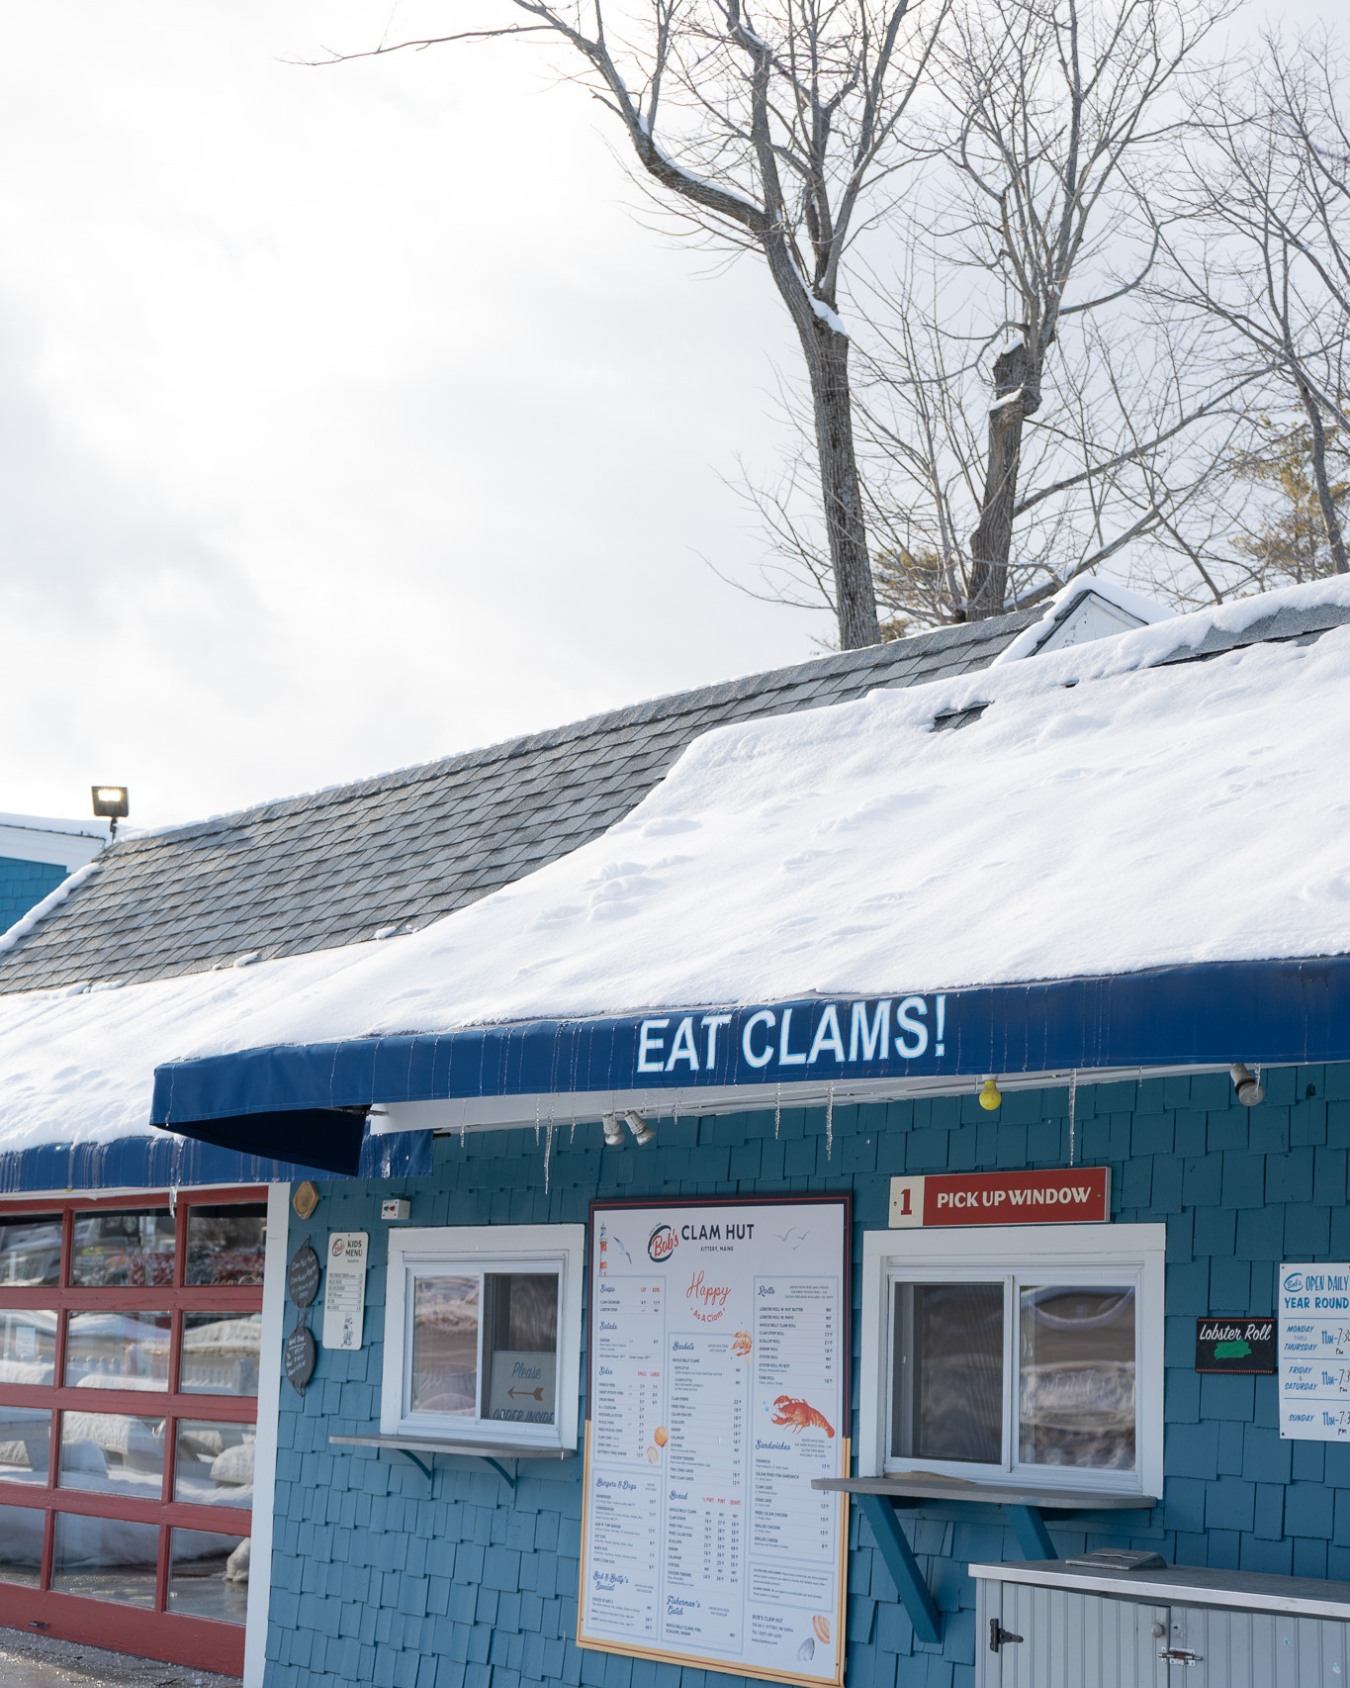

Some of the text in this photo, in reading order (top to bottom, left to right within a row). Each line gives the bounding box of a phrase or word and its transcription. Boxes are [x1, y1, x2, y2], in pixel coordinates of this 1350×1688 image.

[637, 994, 946, 1073] EAT CLAMS!
[900, 1187, 1091, 1215] 1 PICK UP WINDOW
[681, 1224, 754, 1240] CLAM HUT
[652, 1229, 678, 1256] Bob's
[686, 1270, 732, 1305] Happy
[1305, 1276, 1349, 1292] OPEN DAILY
[1284, 1297, 1349, 1309] YEAR ROUND
[693, 1310, 701, 1320] As
[706, 1310, 723, 1323] Clam
[1200, 1323, 1272, 1341] Lobster Roll
[1287, 1325, 1315, 1333] MONDAY
[512, 1361, 542, 1380] Please
[755, 1440, 790, 1450] Sandwiches
[596, 1477, 616, 1488] Burgers
[622, 1480, 636, 1491] Dogs
[666, 1596, 701, 1608] Fisherman's
[667, 1606, 683, 1615] Catch
